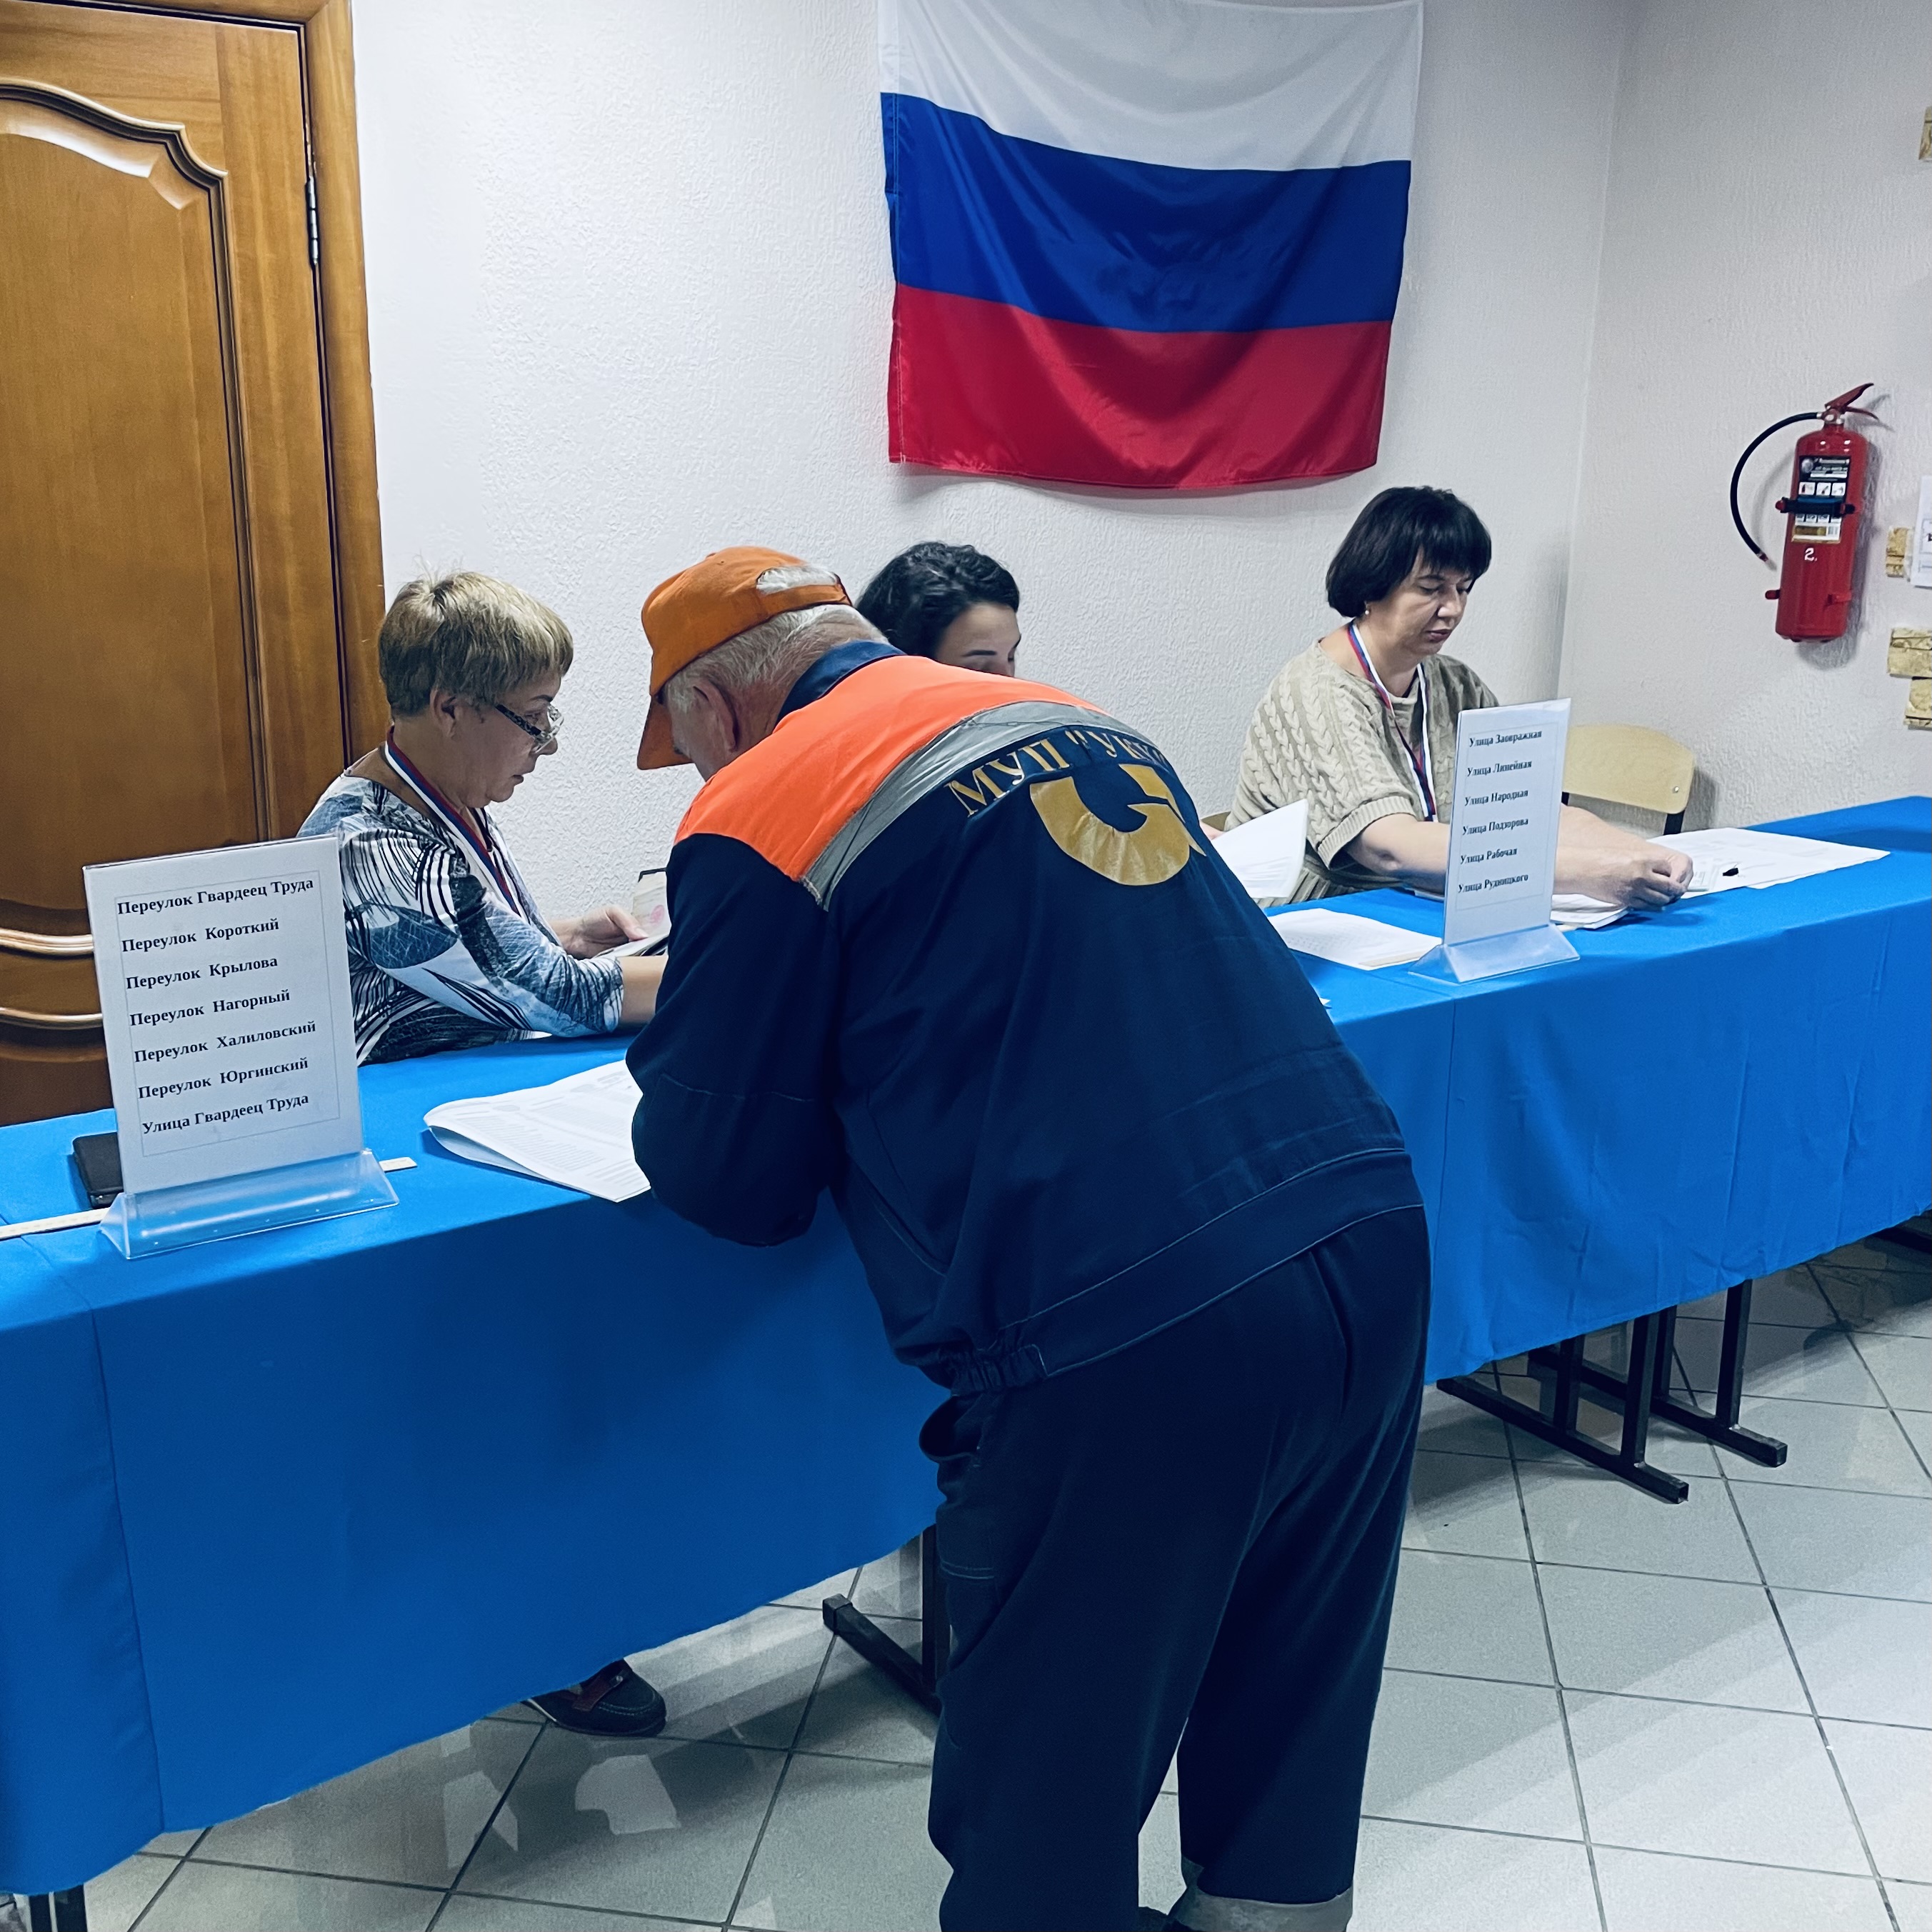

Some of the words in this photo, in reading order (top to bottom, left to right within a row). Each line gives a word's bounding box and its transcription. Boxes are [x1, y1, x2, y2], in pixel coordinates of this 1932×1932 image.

[1469, 737, 1493, 747] Улица
[944, 738, 1070, 817] МУП
[1467, 766, 1491, 776] Улица
[1492, 760, 1531, 772] Линейная
[1464, 796, 1488, 806] Улица
[1491, 790, 1528, 803] Народная
[1462, 825, 1486, 835] Улица
[1460, 854, 1483, 864] Улица
[1486, 848, 1517, 859] Рабочая
[117, 896, 194, 915] Переулок
[197, 886, 268, 904] Гвардеец
[270, 880, 314, 896] Труда
[1458, 883, 1482, 893] Улица
[121, 933, 197, 953] Переулок
[205, 917, 279, 941] Короткий
[126, 969, 201, 989] Переулок
[209, 958, 278, 978] Крылова
[129, 1006, 204, 1026] Переулок
[212, 988, 290, 1013] Нагорный
[134, 1042, 209, 1063] Переулок
[216, 1020, 316, 1048] Халиловский
[138, 1078, 212, 1099] Переулок
[219, 1056, 308, 1084] Юргинский
[142, 1118, 190, 1134] Улица
[194, 1104, 264, 1125] Гвардеец
[266, 1095, 309, 1112] Труда
